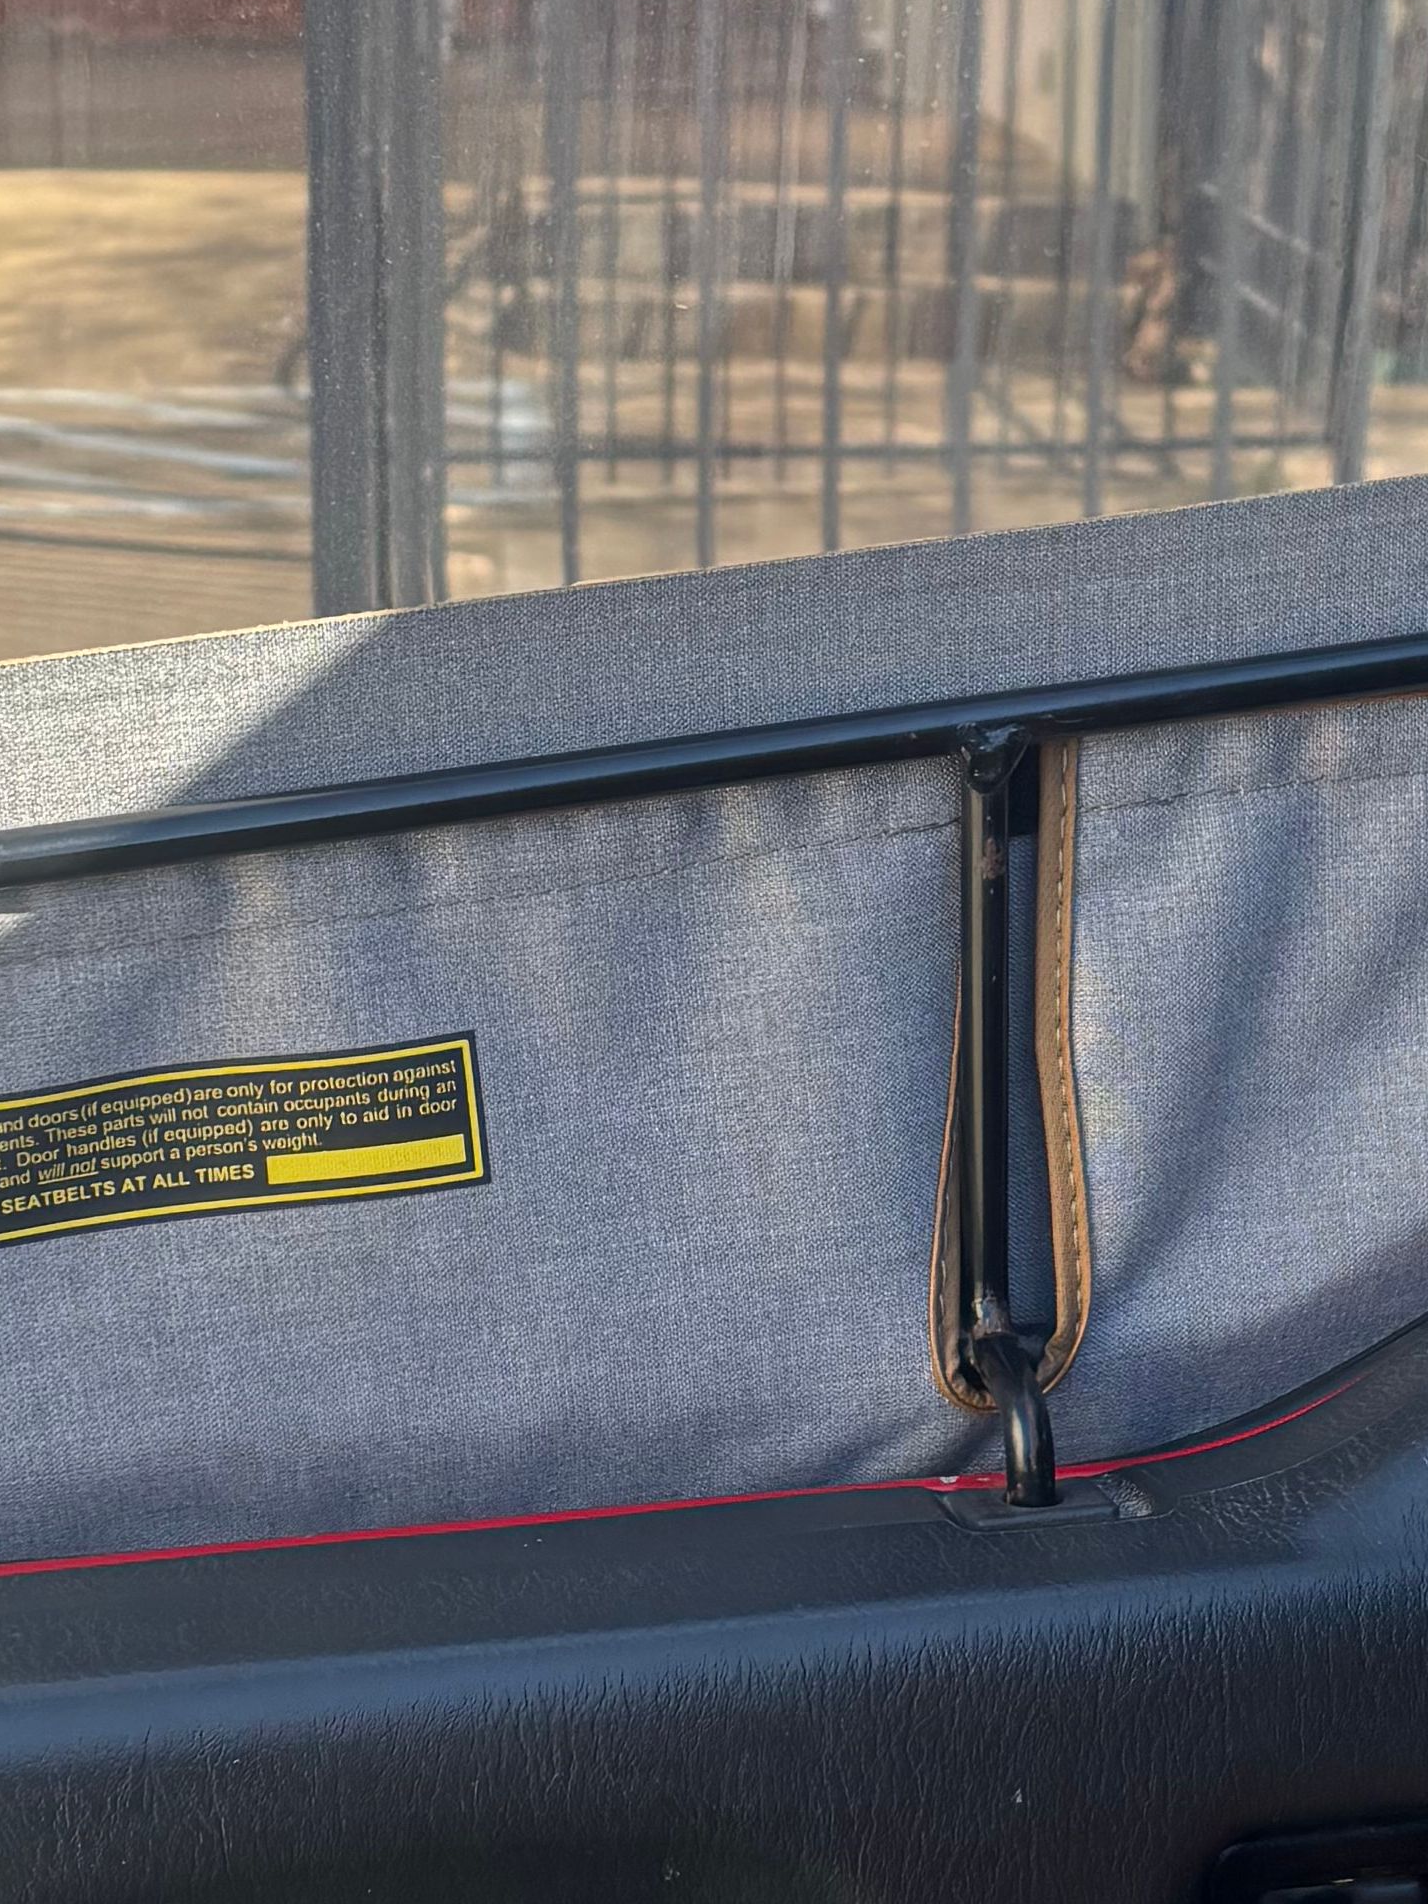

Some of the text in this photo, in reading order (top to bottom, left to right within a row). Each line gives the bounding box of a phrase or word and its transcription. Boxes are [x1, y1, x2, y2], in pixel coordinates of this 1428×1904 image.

[226, 1081, 264, 1100] only
[269, 1079, 294, 1095] for
[299, 1071, 389, 1095] protection
[392, 1059, 457, 1084] against
[16, 1147, 60, 1168] Door
[66, 1135, 137, 1158] handles
[141, 1127, 159, 1148] (if
[163, 1119, 254, 1142] equipped)
[260, 1118, 289, 1133] are
[296, 1112, 333, 1131] only
[339, 1111, 358, 1125] to
[362, 1106, 390, 1122] aid
[396, 1104, 413, 1120] in
[419, 1098, 457, 1116] door
[44, 1123, 98, 1144] These
[102, 1113, 145, 1135] parts
[149, 1107, 177, 1125] will
[181, 1102, 208, 1121] not
[217, 1099, 279, 1118] contain
[283, 1091, 371, 1112] occupants
[377, 1084, 430, 1103] during
[436, 1079, 457, 1095] an
[37, 1162, 66, 1182] will
[70, 1156, 98, 1175] not
[100, 1147, 165, 1169] support
[169, 1147, 181, 1160] a
[185, 1137, 258, 1161] person's
[261, 1131, 322, 1151] weight.
[1, 1180, 116, 1215] SEATBELTS
[121, 1175, 147, 1193] AT
[152, 1171, 191, 1189] ALL
[194, 1163, 255, 1184] TIMES
